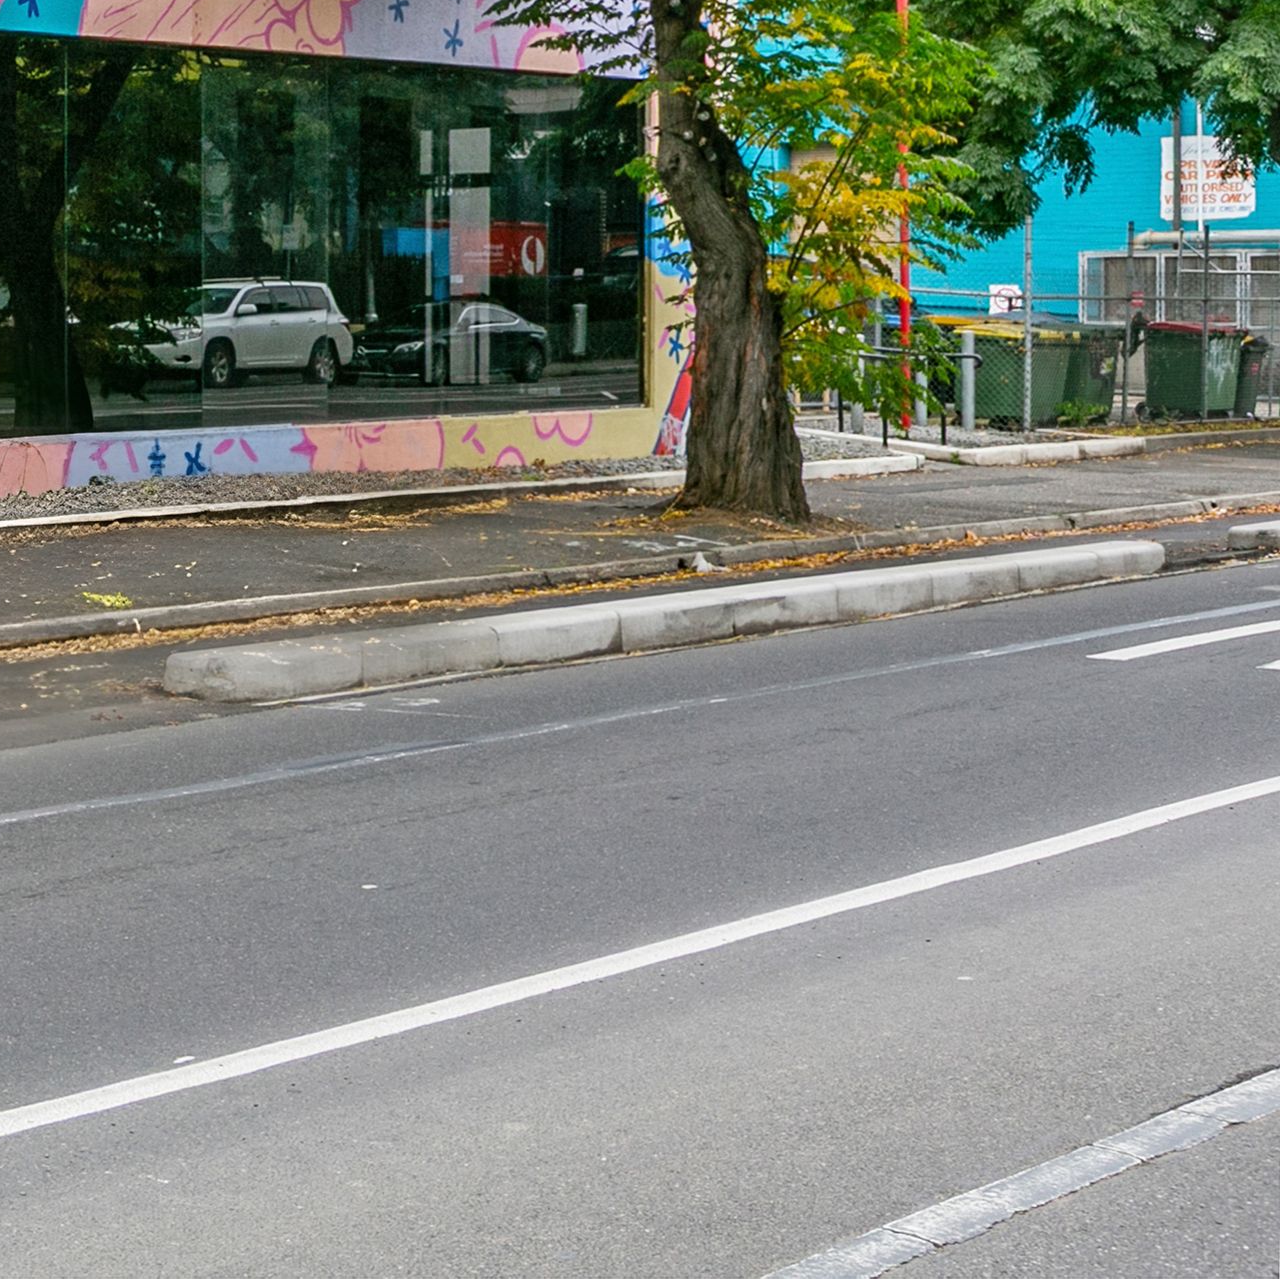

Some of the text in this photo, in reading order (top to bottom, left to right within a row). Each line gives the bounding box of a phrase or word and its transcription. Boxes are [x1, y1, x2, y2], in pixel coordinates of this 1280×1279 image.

[1164, 170, 1198, 181] CAR
[1176, 182, 1244, 193] UTORISED
[1164, 192, 1252, 204] VHICES ONLY
